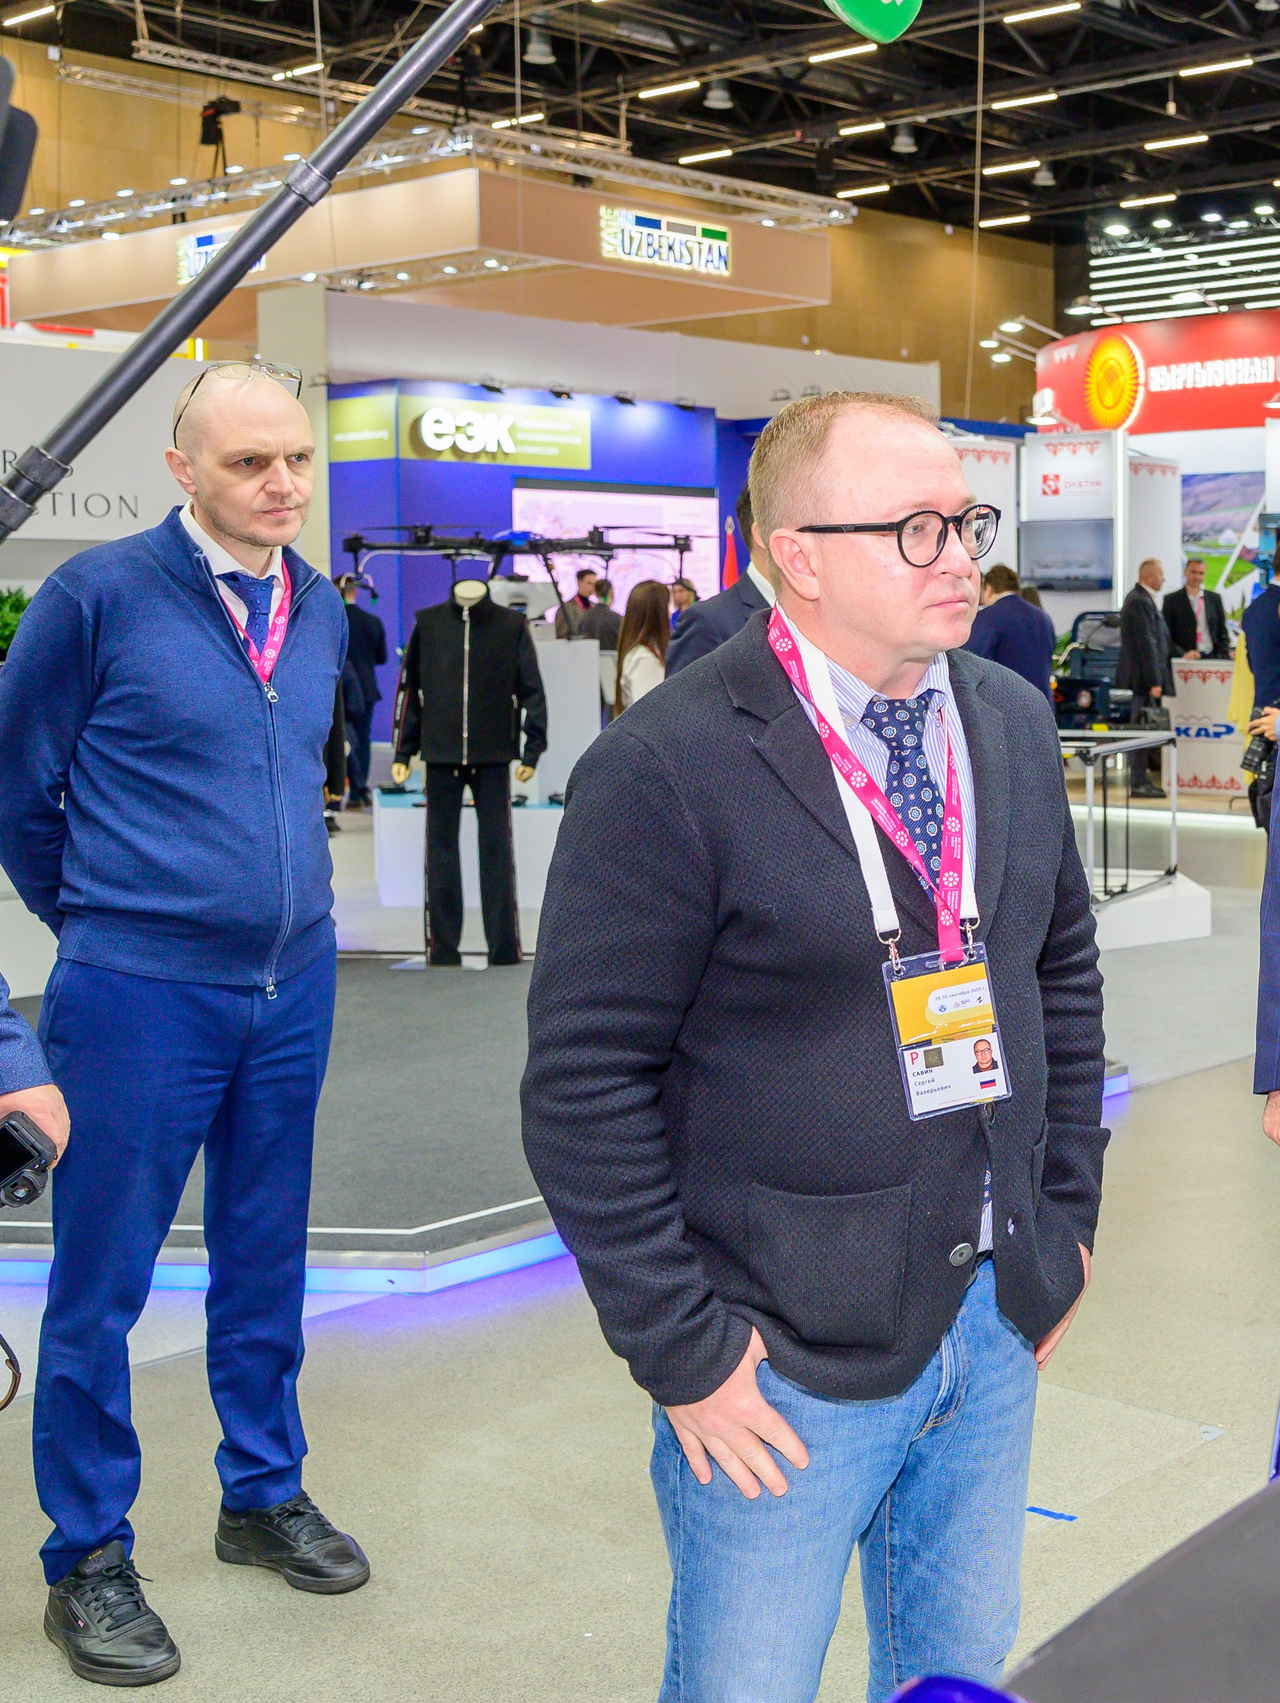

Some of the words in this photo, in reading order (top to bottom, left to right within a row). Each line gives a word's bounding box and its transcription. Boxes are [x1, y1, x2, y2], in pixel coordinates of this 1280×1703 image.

[618, 227, 730, 276] UZBEKISTAN
[1149, 355, 1275, 392] КЫРГЫЗСКАЯ
[912, 1068, 934, 1077] САВИН
[914, 1077, 935, 1087] Сергей
[915, 1085, 952, 1096] Валерьевич
